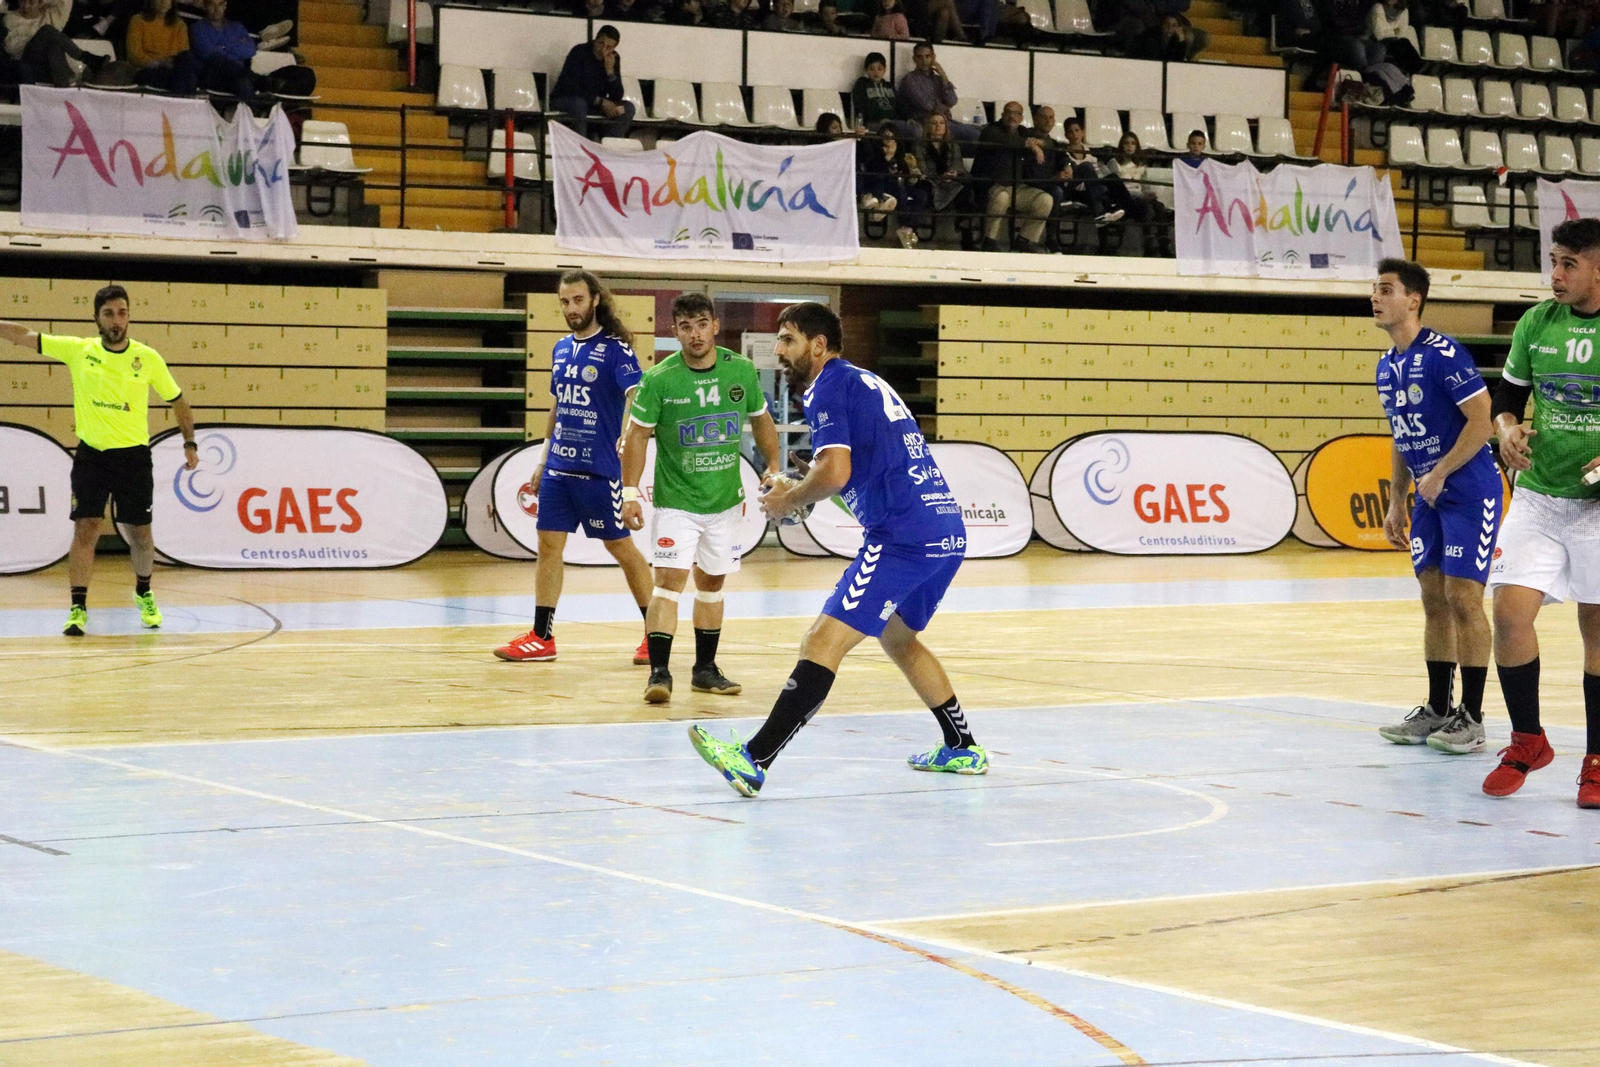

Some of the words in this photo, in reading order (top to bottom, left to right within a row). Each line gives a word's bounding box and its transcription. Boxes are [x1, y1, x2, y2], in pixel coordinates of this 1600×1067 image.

[574, 143, 838, 219] Andalucía
[1572, 326, 1596, 334] UCLM
[1566, 337, 1593, 364] 10
[564, 364, 578, 378] 14
[556, 383, 591, 406] GAES
[695, 385, 721, 408] 14
[860, 373, 916, 422] 2
[93, 399, 122, 411] helvetia
[696, 452, 736, 466] BOLAÑOS
[237, 487, 363, 534] GAES
[1134, 484, 1230, 524] GAES
[589, 518, 604, 529] GAES
[1139, 535, 1236, 546] CentrosAuditivos
[240, 548, 368, 560] CentrosAuditivos
[1445, 544, 1464, 558] GAES
